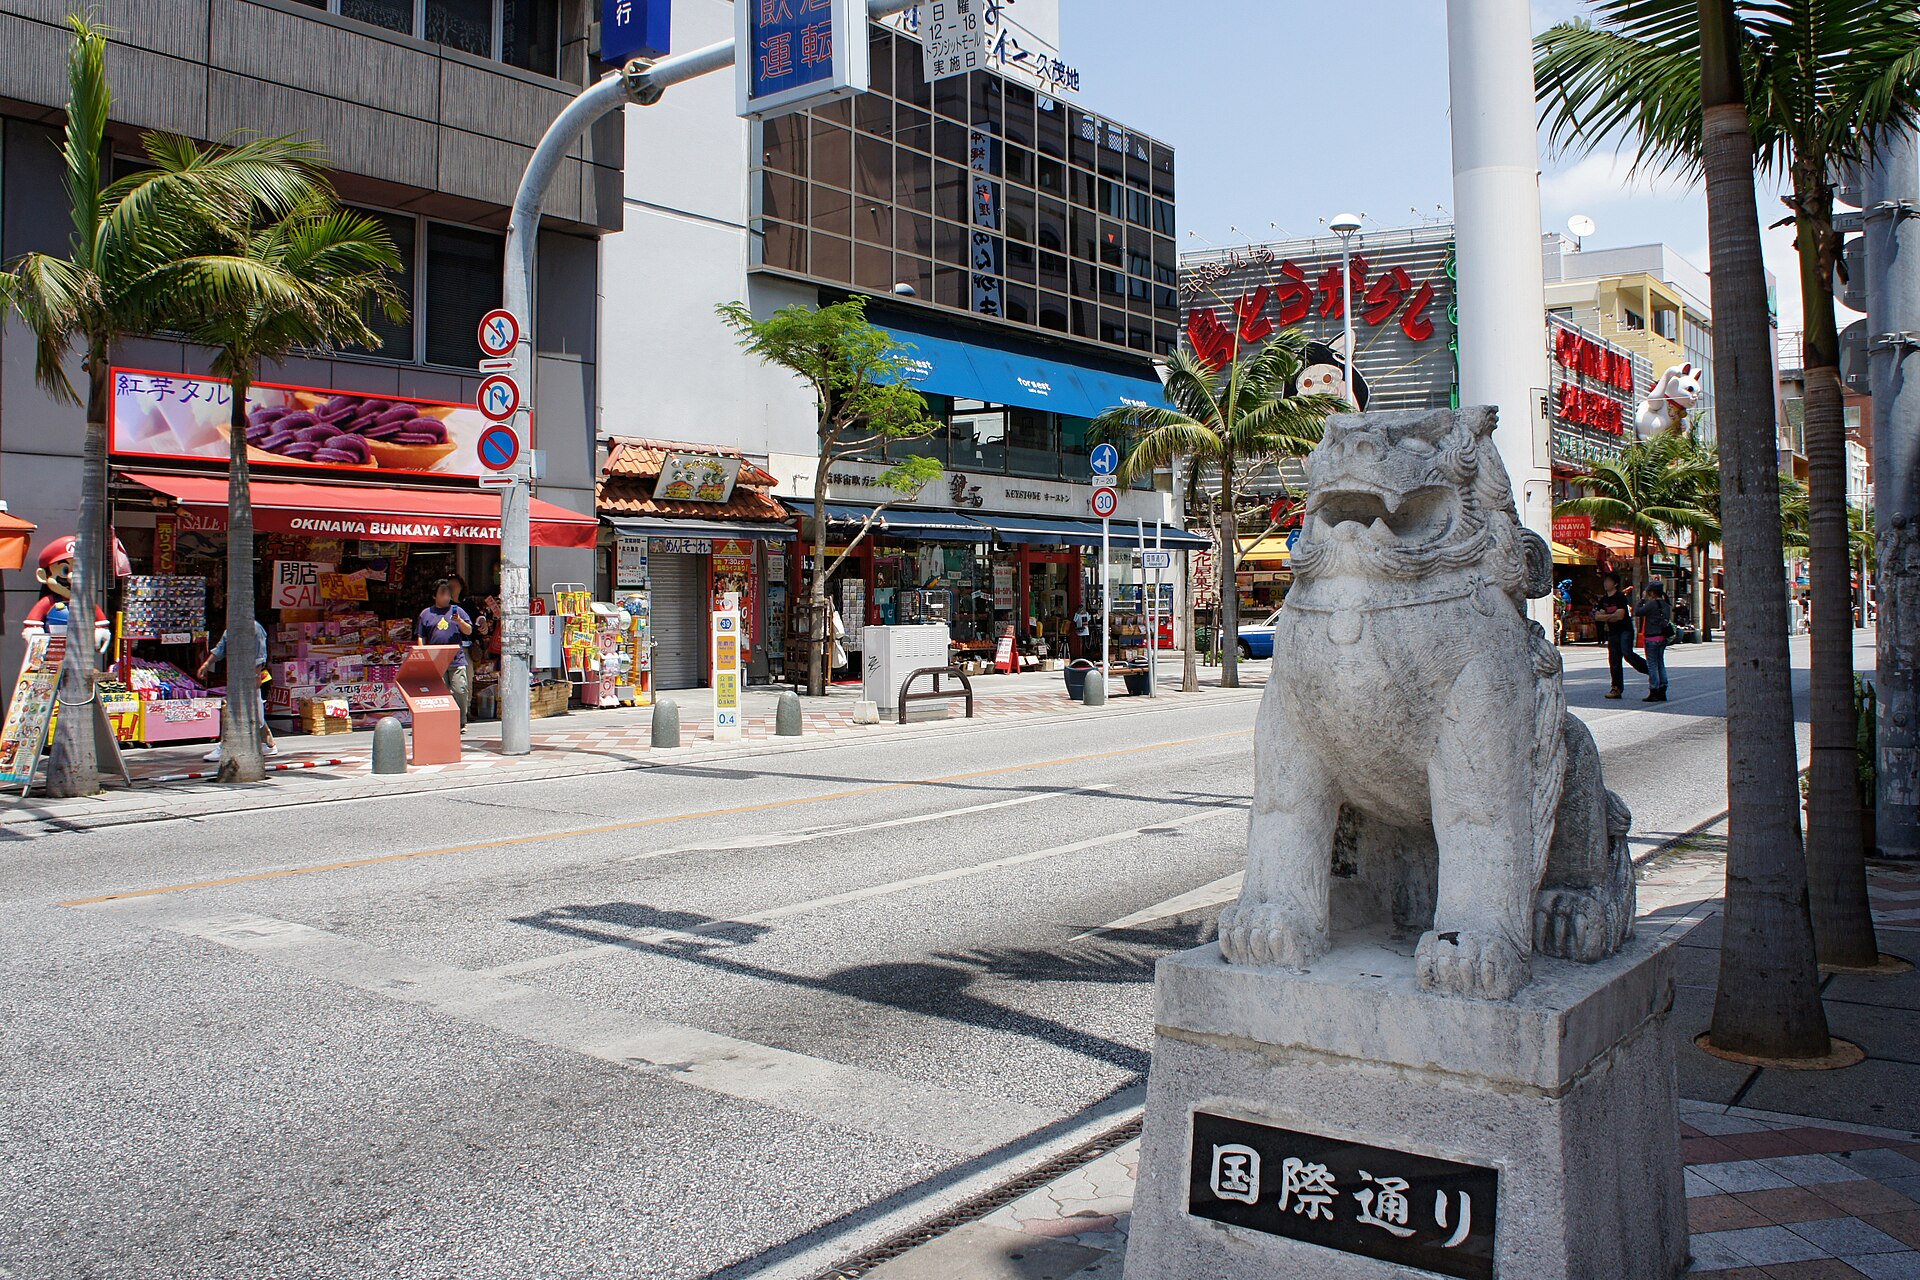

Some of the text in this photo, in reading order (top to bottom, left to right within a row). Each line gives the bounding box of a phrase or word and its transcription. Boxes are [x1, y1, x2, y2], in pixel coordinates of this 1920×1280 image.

[929, 23, 942, 41] 12
[963, 14, 977, 32] 18
[760, 20, 833, 82] 運転
[926, 32, 981, 61] トランジットモール
[934, 51, 976, 76] 実施日
[117, 374, 253, 406] 紅芋タル
[1005, 489, 1041, 501] KEYSTONE
[1097, 495, 1112, 510] 30
[290, 518, 366, 534] OKINAWA
[370, 522, 440, 538] BUNKAYA
[280, 562, 318, 585] 閉店
[279, 586, 333, 608] SAL
[329, 584, 368, 600] SALE
[721, 620, 731, 628] 39
[718, 713, 735, 724] 0.4
[1210, 1143, 1471, 1248] 国際通り
